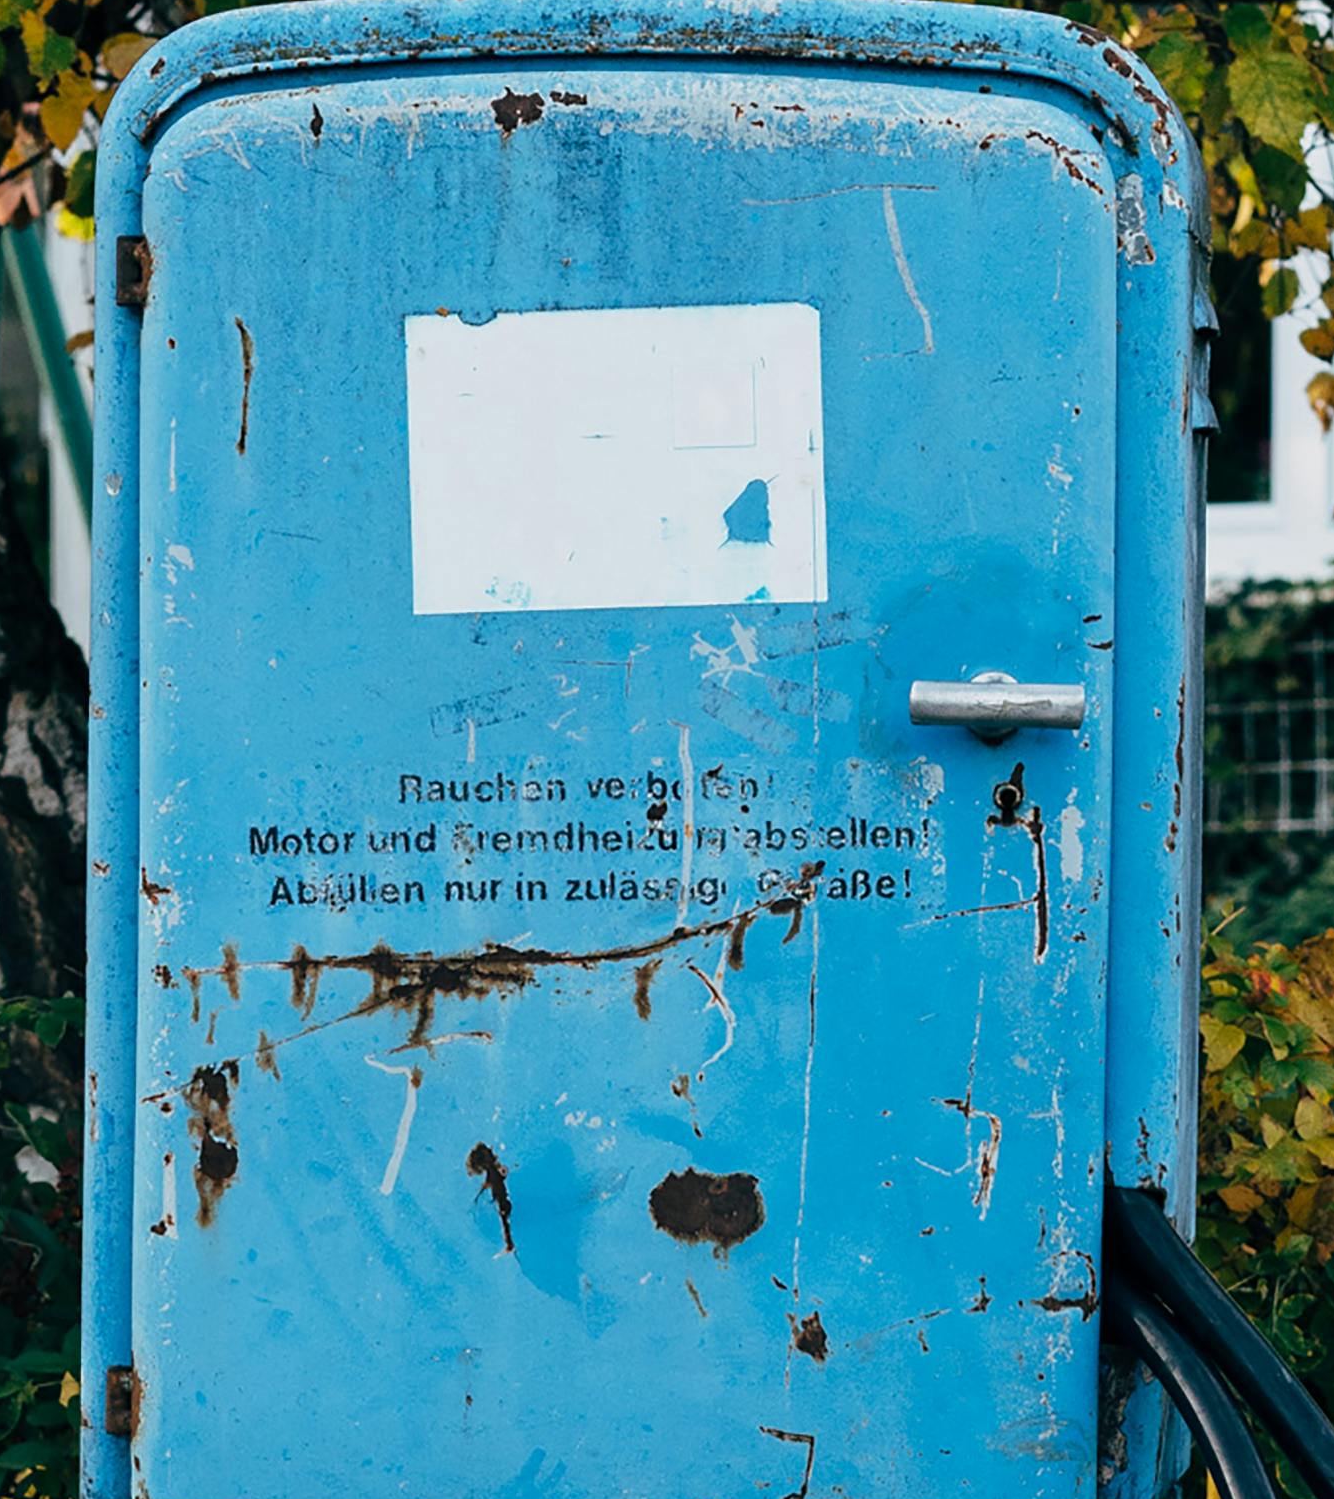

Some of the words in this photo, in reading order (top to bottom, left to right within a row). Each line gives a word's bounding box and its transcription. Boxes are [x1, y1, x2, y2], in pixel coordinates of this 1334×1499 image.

[398, 772, 566, 803] Rauchen
[249, 825, 356, 856] Motor
[367, 822, 436, 853] und
[743, 816, 929, 851] absellen!
[445, 877, 503, 903] nur
[516, 872, 547, 901] in
